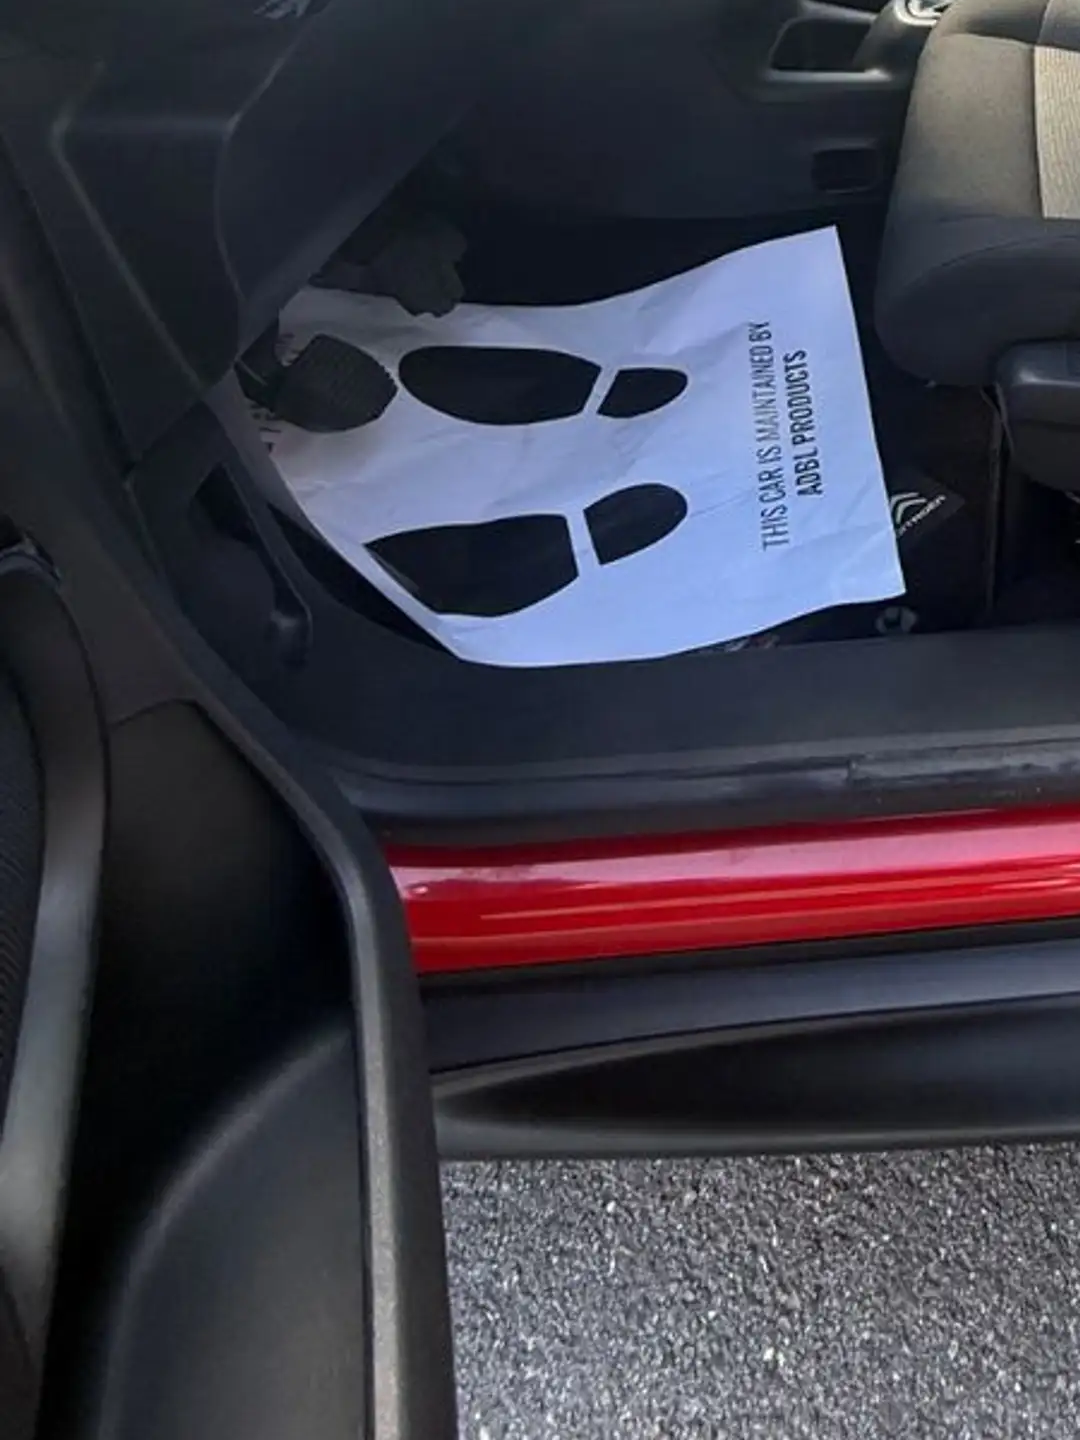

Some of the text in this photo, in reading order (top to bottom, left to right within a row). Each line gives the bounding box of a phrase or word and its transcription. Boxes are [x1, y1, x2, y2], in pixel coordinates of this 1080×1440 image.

[747, 321, 789, 551] THIS CAR IS MAINTAINED BY
[783, 350, 823, 496] ADBL PRODUCTS
